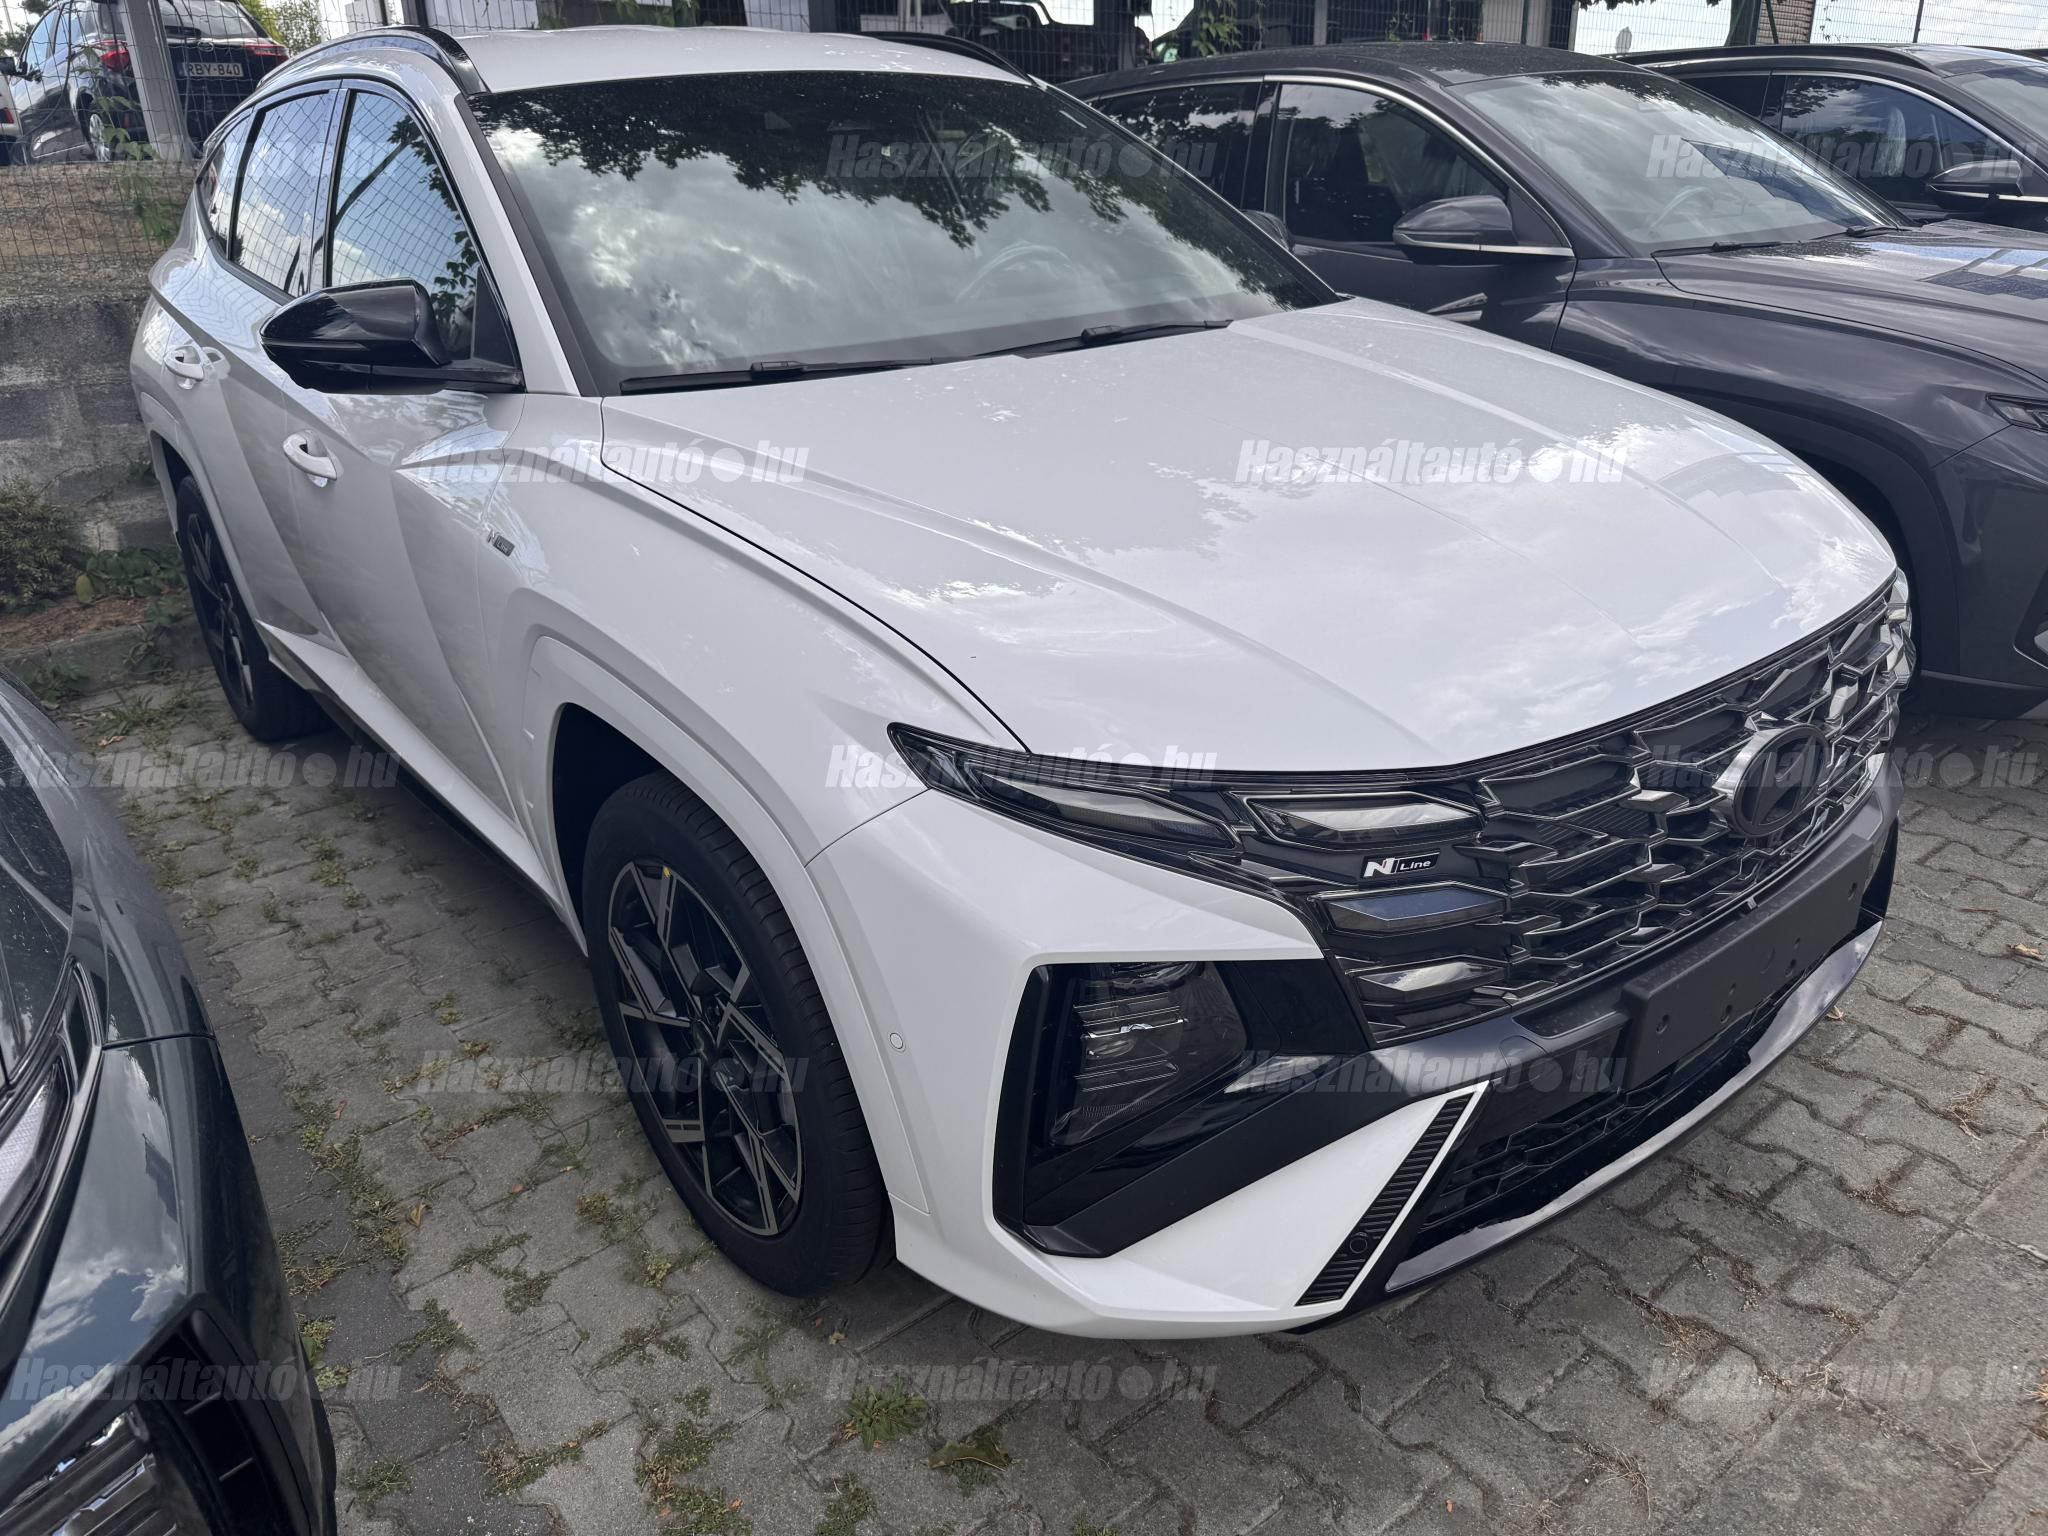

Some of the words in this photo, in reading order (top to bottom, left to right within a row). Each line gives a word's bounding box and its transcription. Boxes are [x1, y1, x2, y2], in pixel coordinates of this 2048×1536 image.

[188, 63, 241, 76] RBY-840
[1363, 857, 1396, 877] N
[1399, 860, 1432, 871] Line
